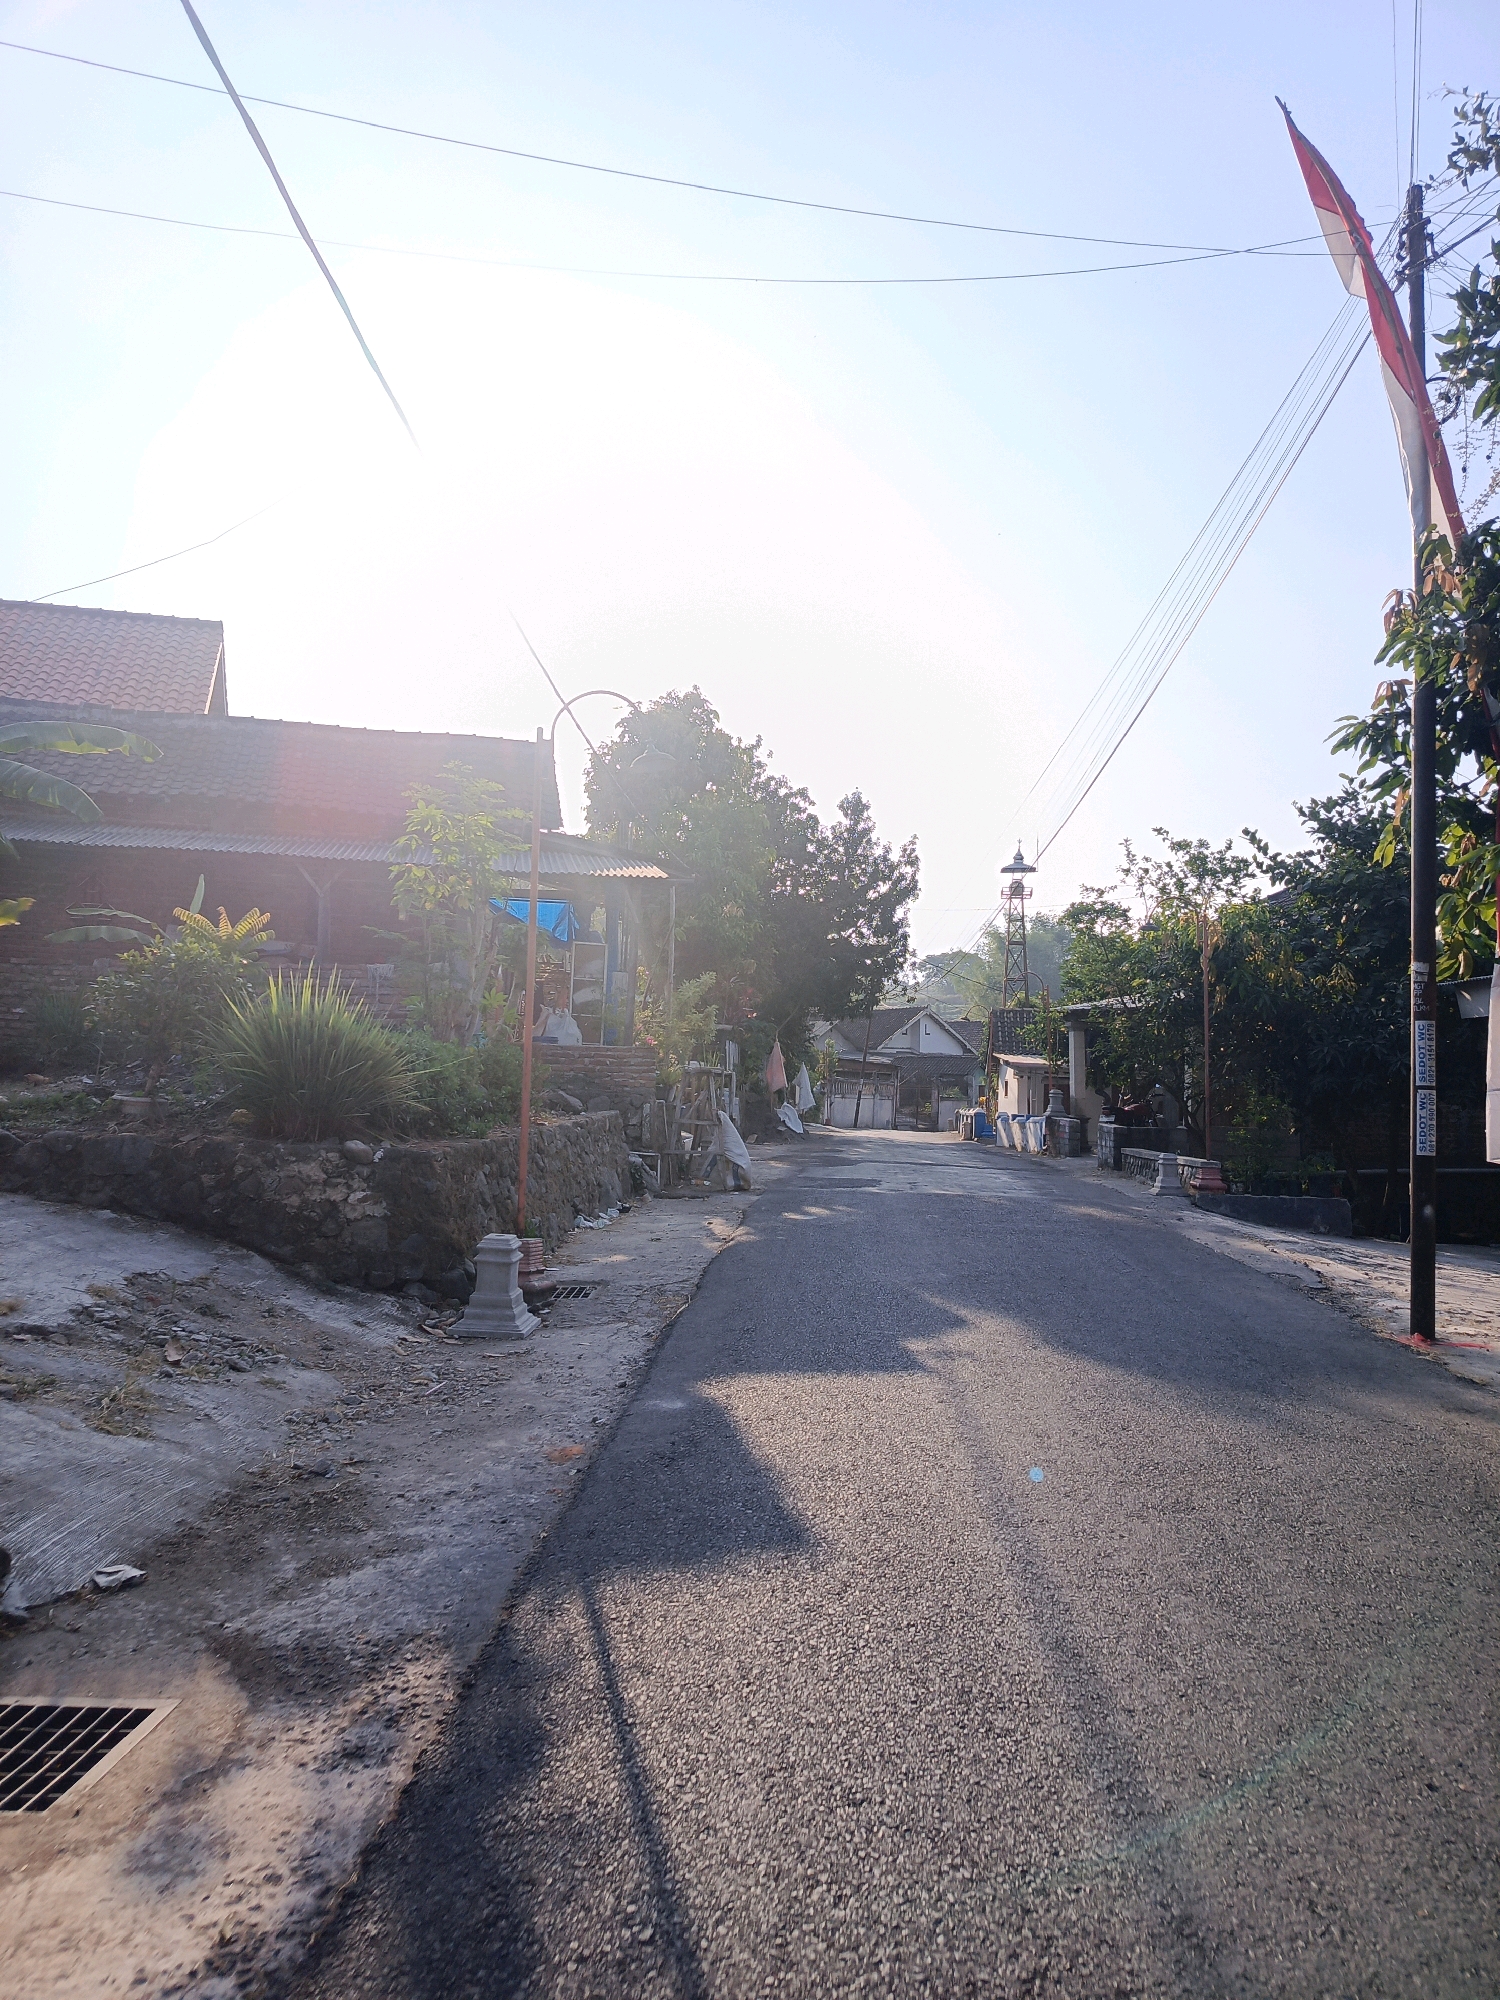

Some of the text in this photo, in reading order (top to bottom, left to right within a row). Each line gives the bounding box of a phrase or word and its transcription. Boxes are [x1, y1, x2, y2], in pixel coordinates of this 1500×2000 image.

[1417, 1023, 1426, 1083] SEDOT WC
[1427, 1045, 1435, 1062] 3151
[1427, 1065, 1435, 1083] 0821
[1428, 1092, 1436, 1107] 007
[1418, 1093, 1427, 1153] SEDOT WC
[1428, 1123, 1436, 1138] 230
[1428, 1140, 1436, 1153] 081
